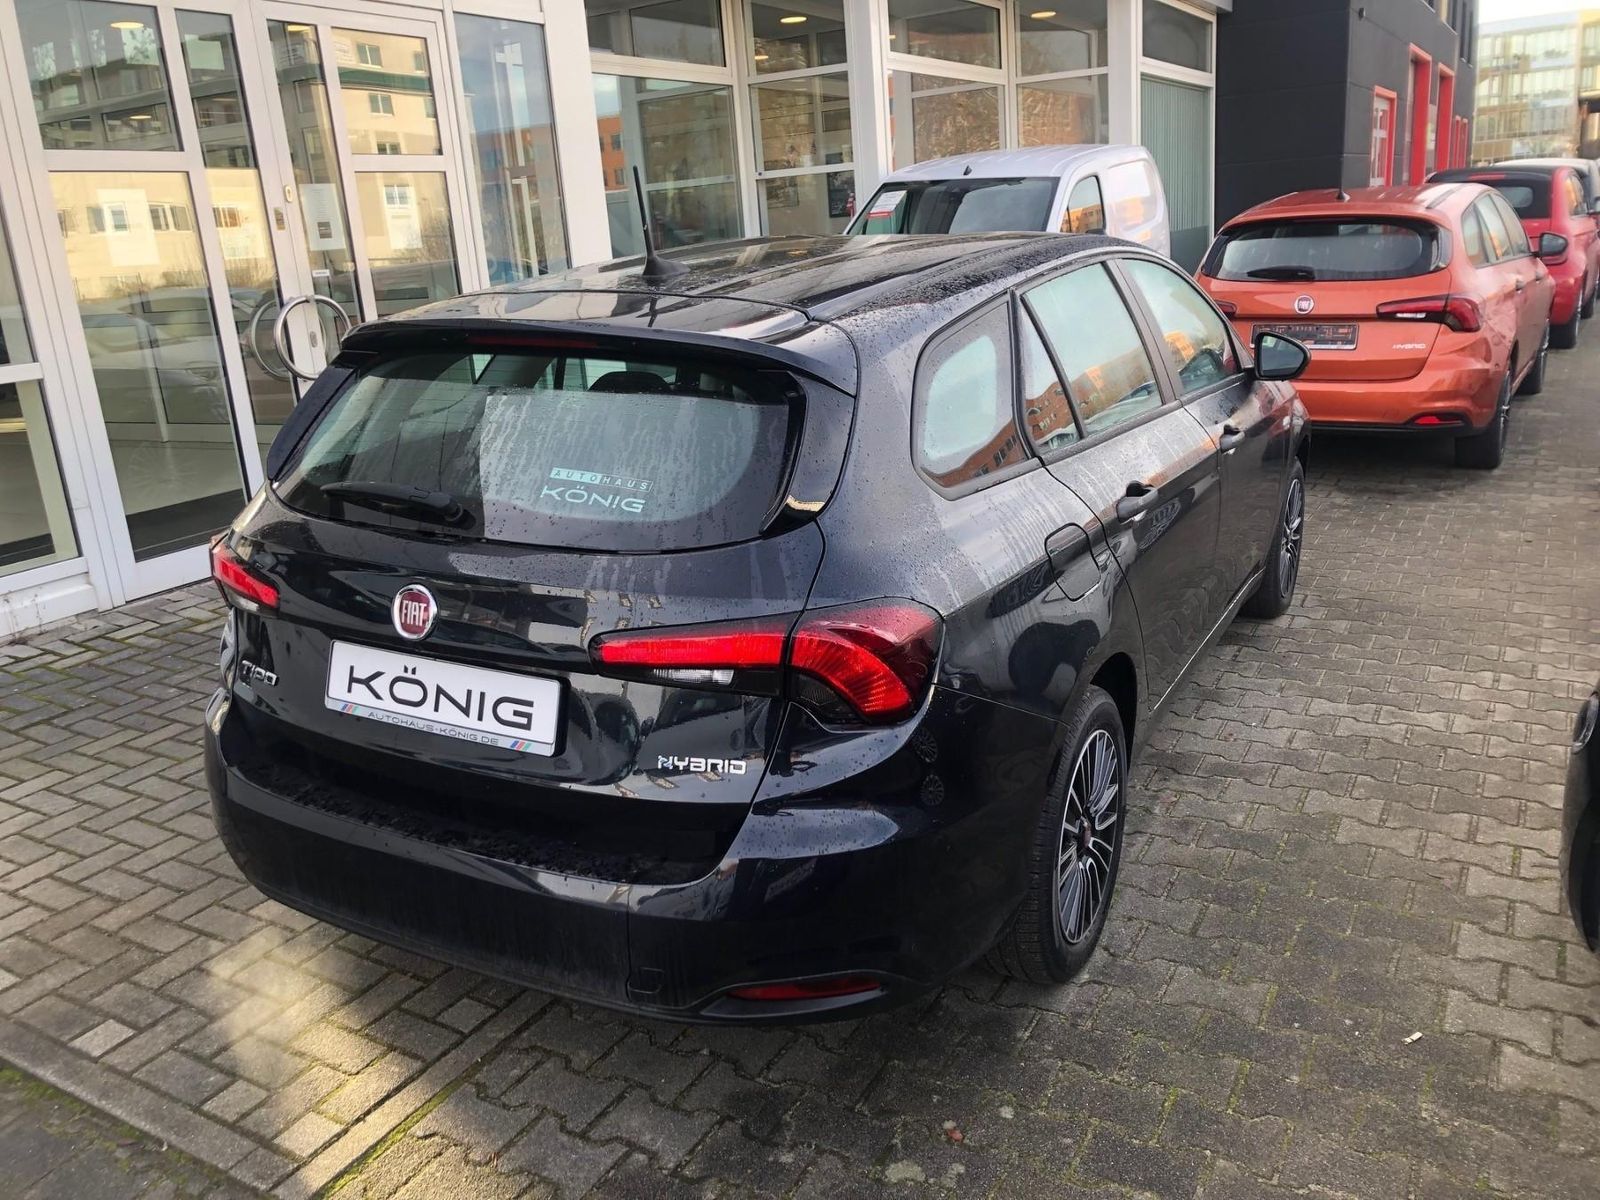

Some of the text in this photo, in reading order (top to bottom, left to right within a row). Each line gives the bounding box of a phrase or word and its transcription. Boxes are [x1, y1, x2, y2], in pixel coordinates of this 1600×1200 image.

[553, 470, 649, 490] AUTOHAUS
[540, 485, 646, 513] KÖNIG
[401, 599, 427, 627] FIAT
[241, 660, 278, 686] TIPO
[347, 664, 535, 731] KÖNIG
[657, 755, 747, 775] HYBRID
